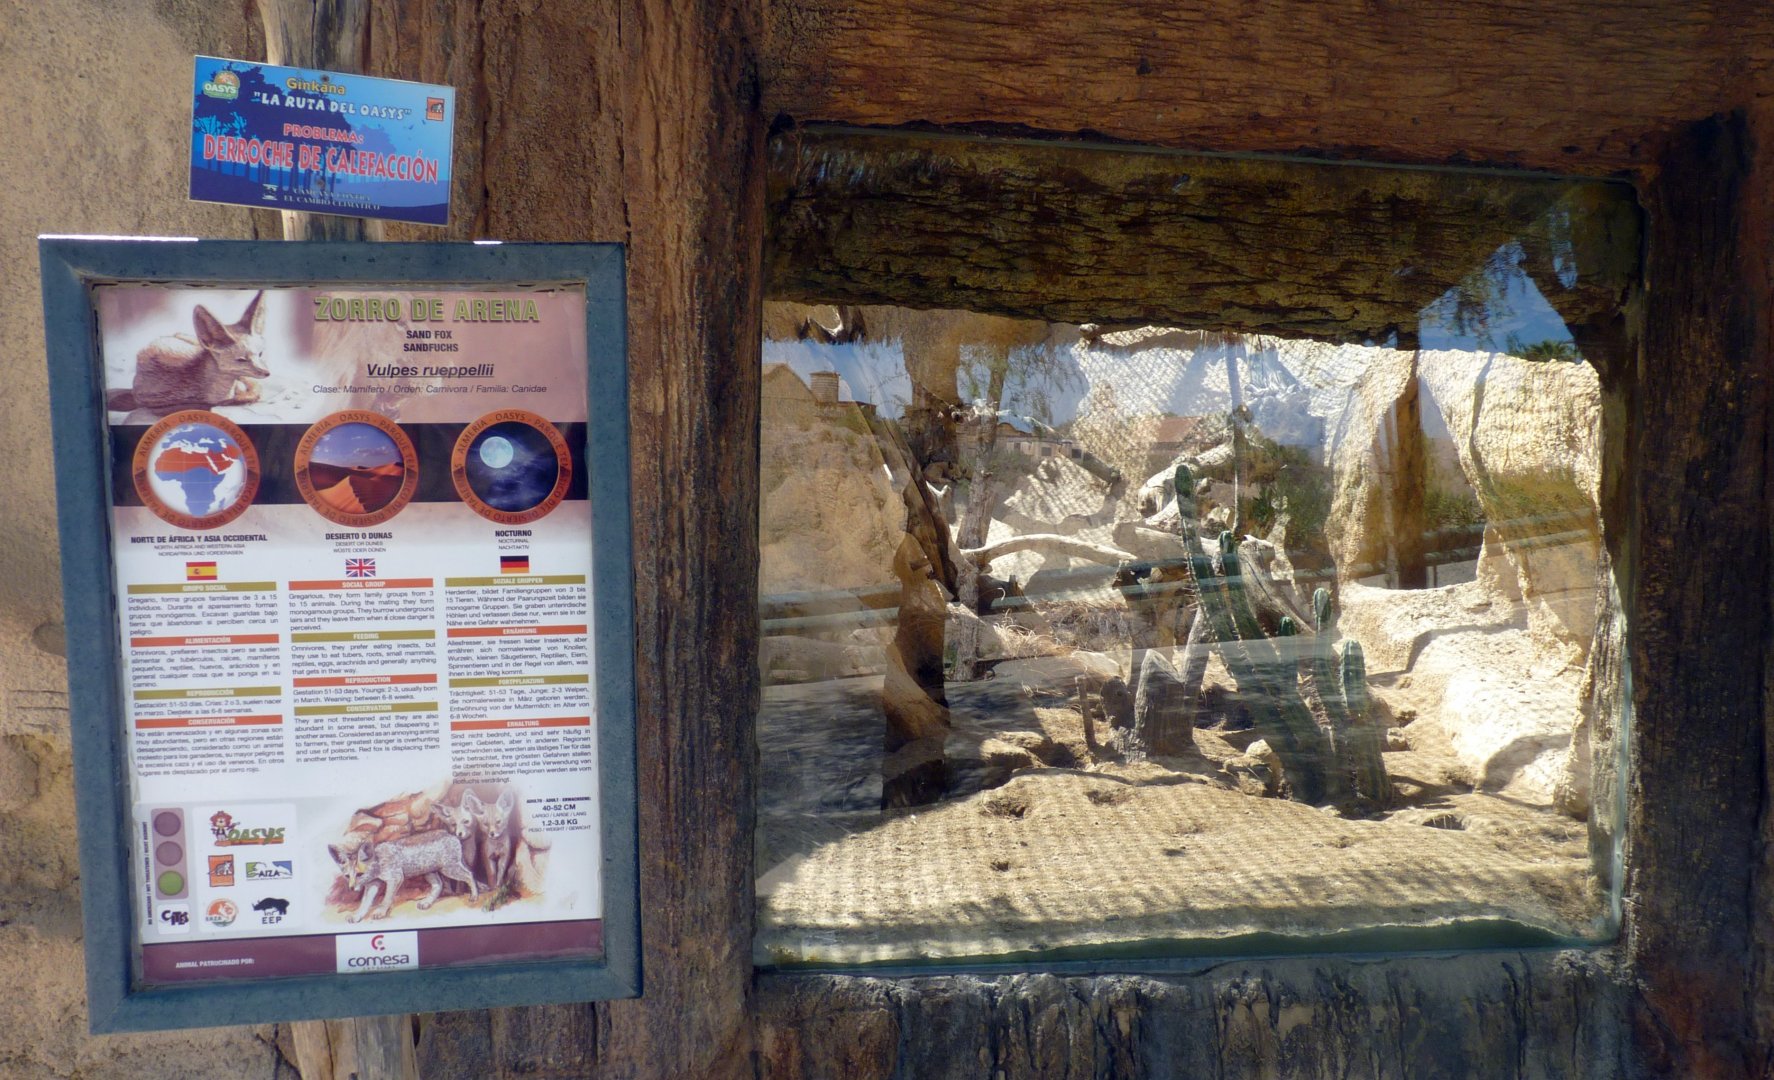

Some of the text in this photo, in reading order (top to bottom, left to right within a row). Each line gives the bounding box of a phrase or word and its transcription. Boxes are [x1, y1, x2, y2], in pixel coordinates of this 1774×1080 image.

[204, 83, 236, 94] OASYS
[286, 77, 346, 95] Ginkana
[285, 95, 325, 112] RUTA
[330, 102, 355, 114] DEL
[283, 123, 364, 144] PROBLEMA:
[203, 134, 438, 184] DERROCHE DE CALEFACCIÓN
[314, 296, 540, 323] ZORRO DE ARENA
[406, 330, 452, 339] SAND FOX
[404, 342, 459, 352] SANDFUCHS
[367, 363, 494, 377] Vulpes rueppellii
[312, 385, 340, 394] Clase:
[387, 385, 391, 394] /
[393, 385, 424, 394] Orden:
[426, 385, 468, 394] Carnivora
[470, 385, 474, 394] /
[476, 385, 509, 394] Familia:
[512, 385, 547, 394] Canidae
[179, 414, 209, 423] OASYS
[496, 412, 526, 421] OASYS
[227, 828, 285, 845] OASYS
[161, 910, 189, 926] CITES
[348, 955, 409, 967] comesa
